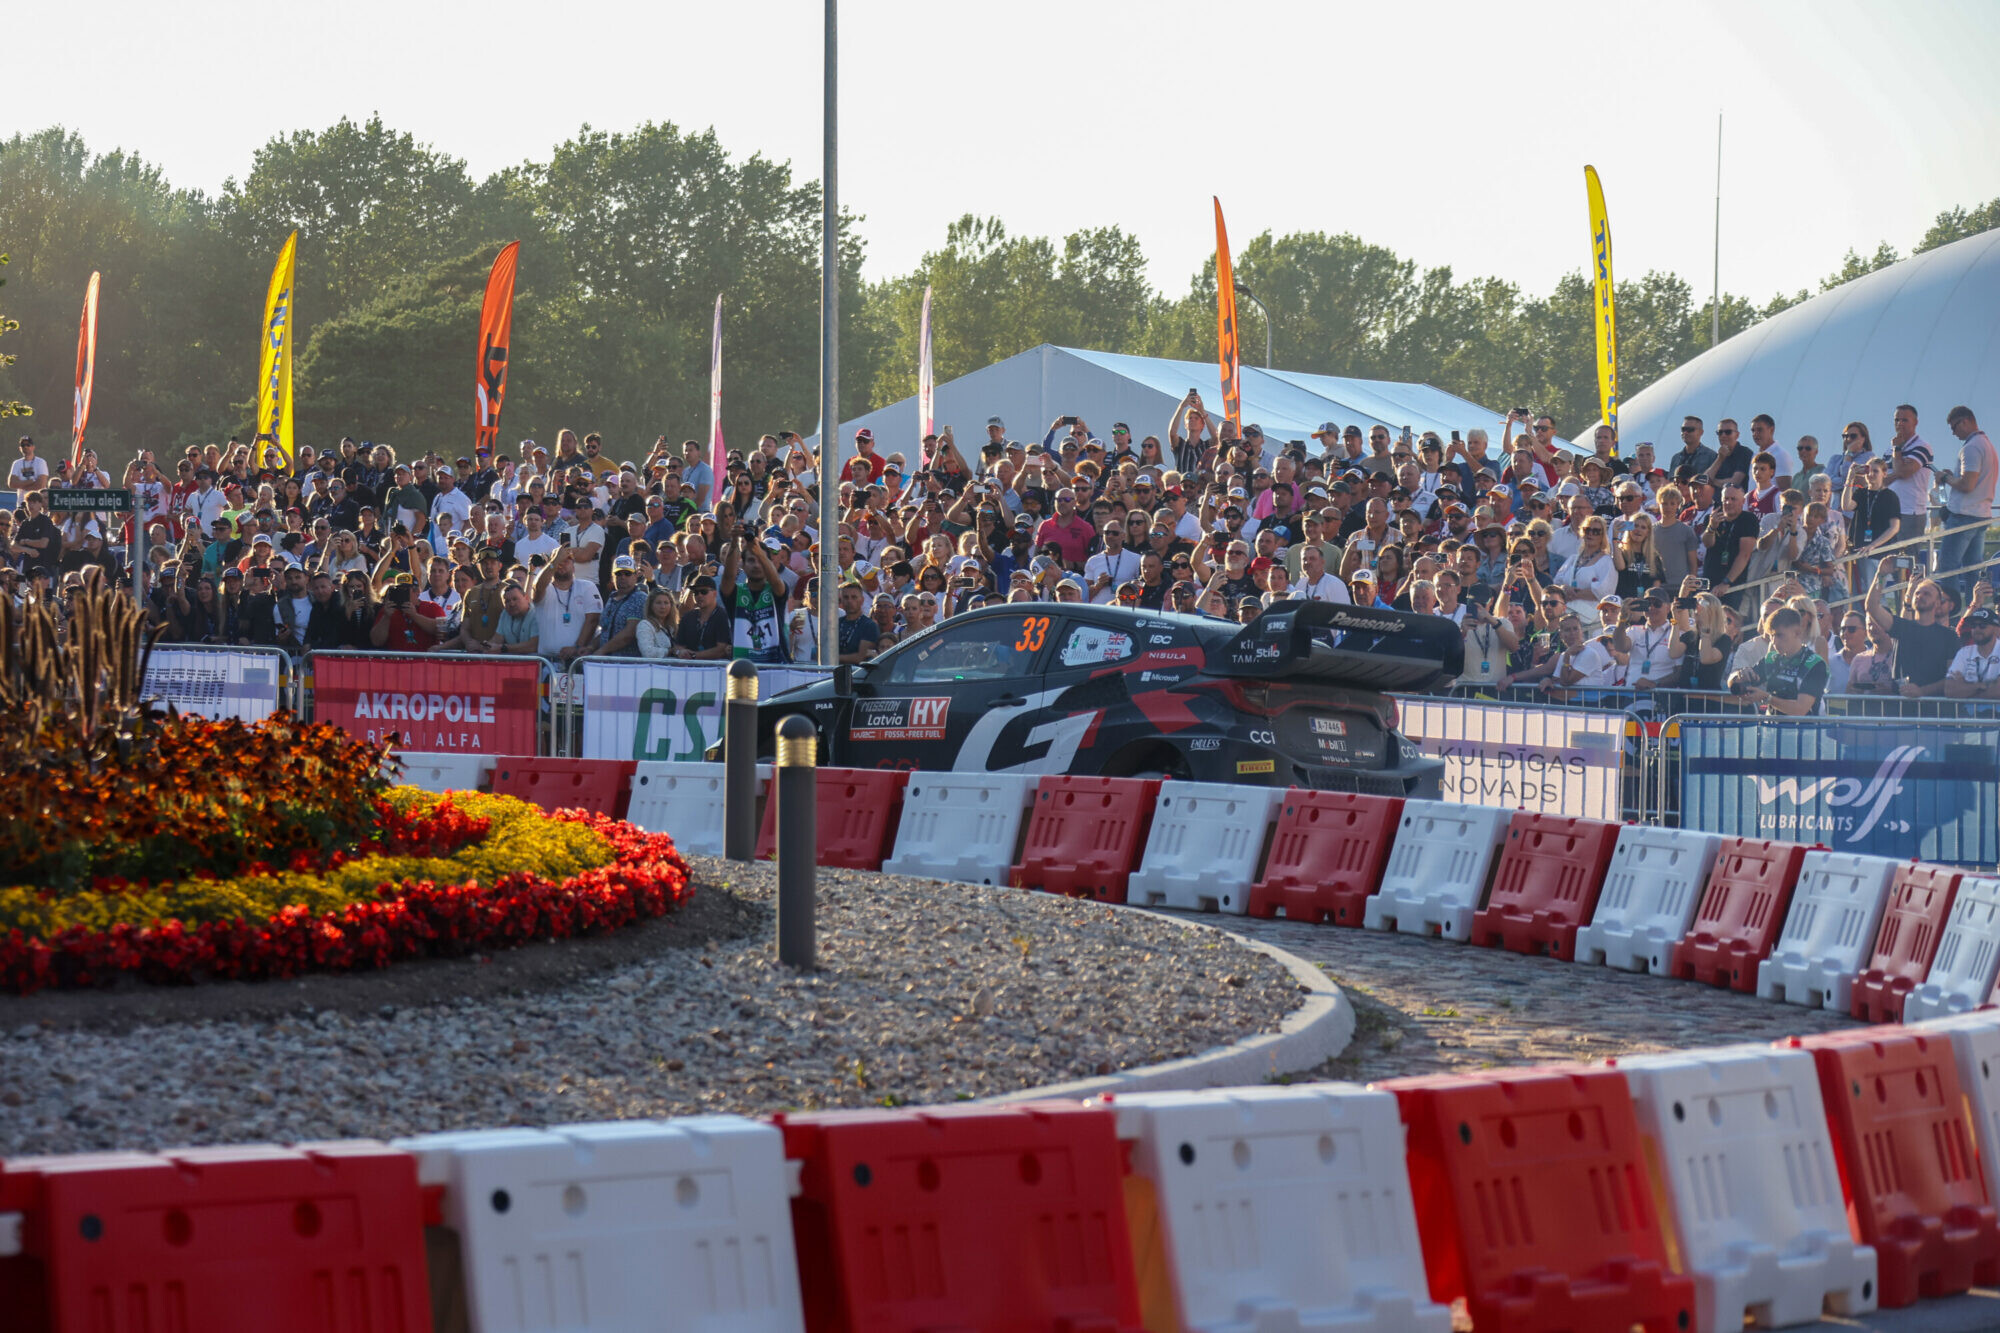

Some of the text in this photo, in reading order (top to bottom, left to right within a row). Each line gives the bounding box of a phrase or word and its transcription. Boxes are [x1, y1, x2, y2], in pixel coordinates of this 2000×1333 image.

[53, 493, 122, 509] Zvejnieku aleja
[1329, 611, 1406, 633] Panasonic
[1014, 617, 1050, 651] 33
[1148, 652, 1187, 660] NISULA
[1256, 643, 1281, 658] Stilo
[1151, 673, 1180, 683] Microsoft
[354, 692, 496, 724] AKROPOLE
[861, 701, 902, 712] MISSION
[912, 700, 947, 725] HY
[867, 713, 904, 726] Latvia
[435, 732, 481, 748] ALFA
[925, 730, 941, 738] FUEL
[1240, 762, 1272, 772] PIRELLI
[1438, 745, 1587, 776] KULDĪGAS
[1441, 775, 1558, 804] NOVADS
[1760, 814, 1854, 832] LUBRICANTS
